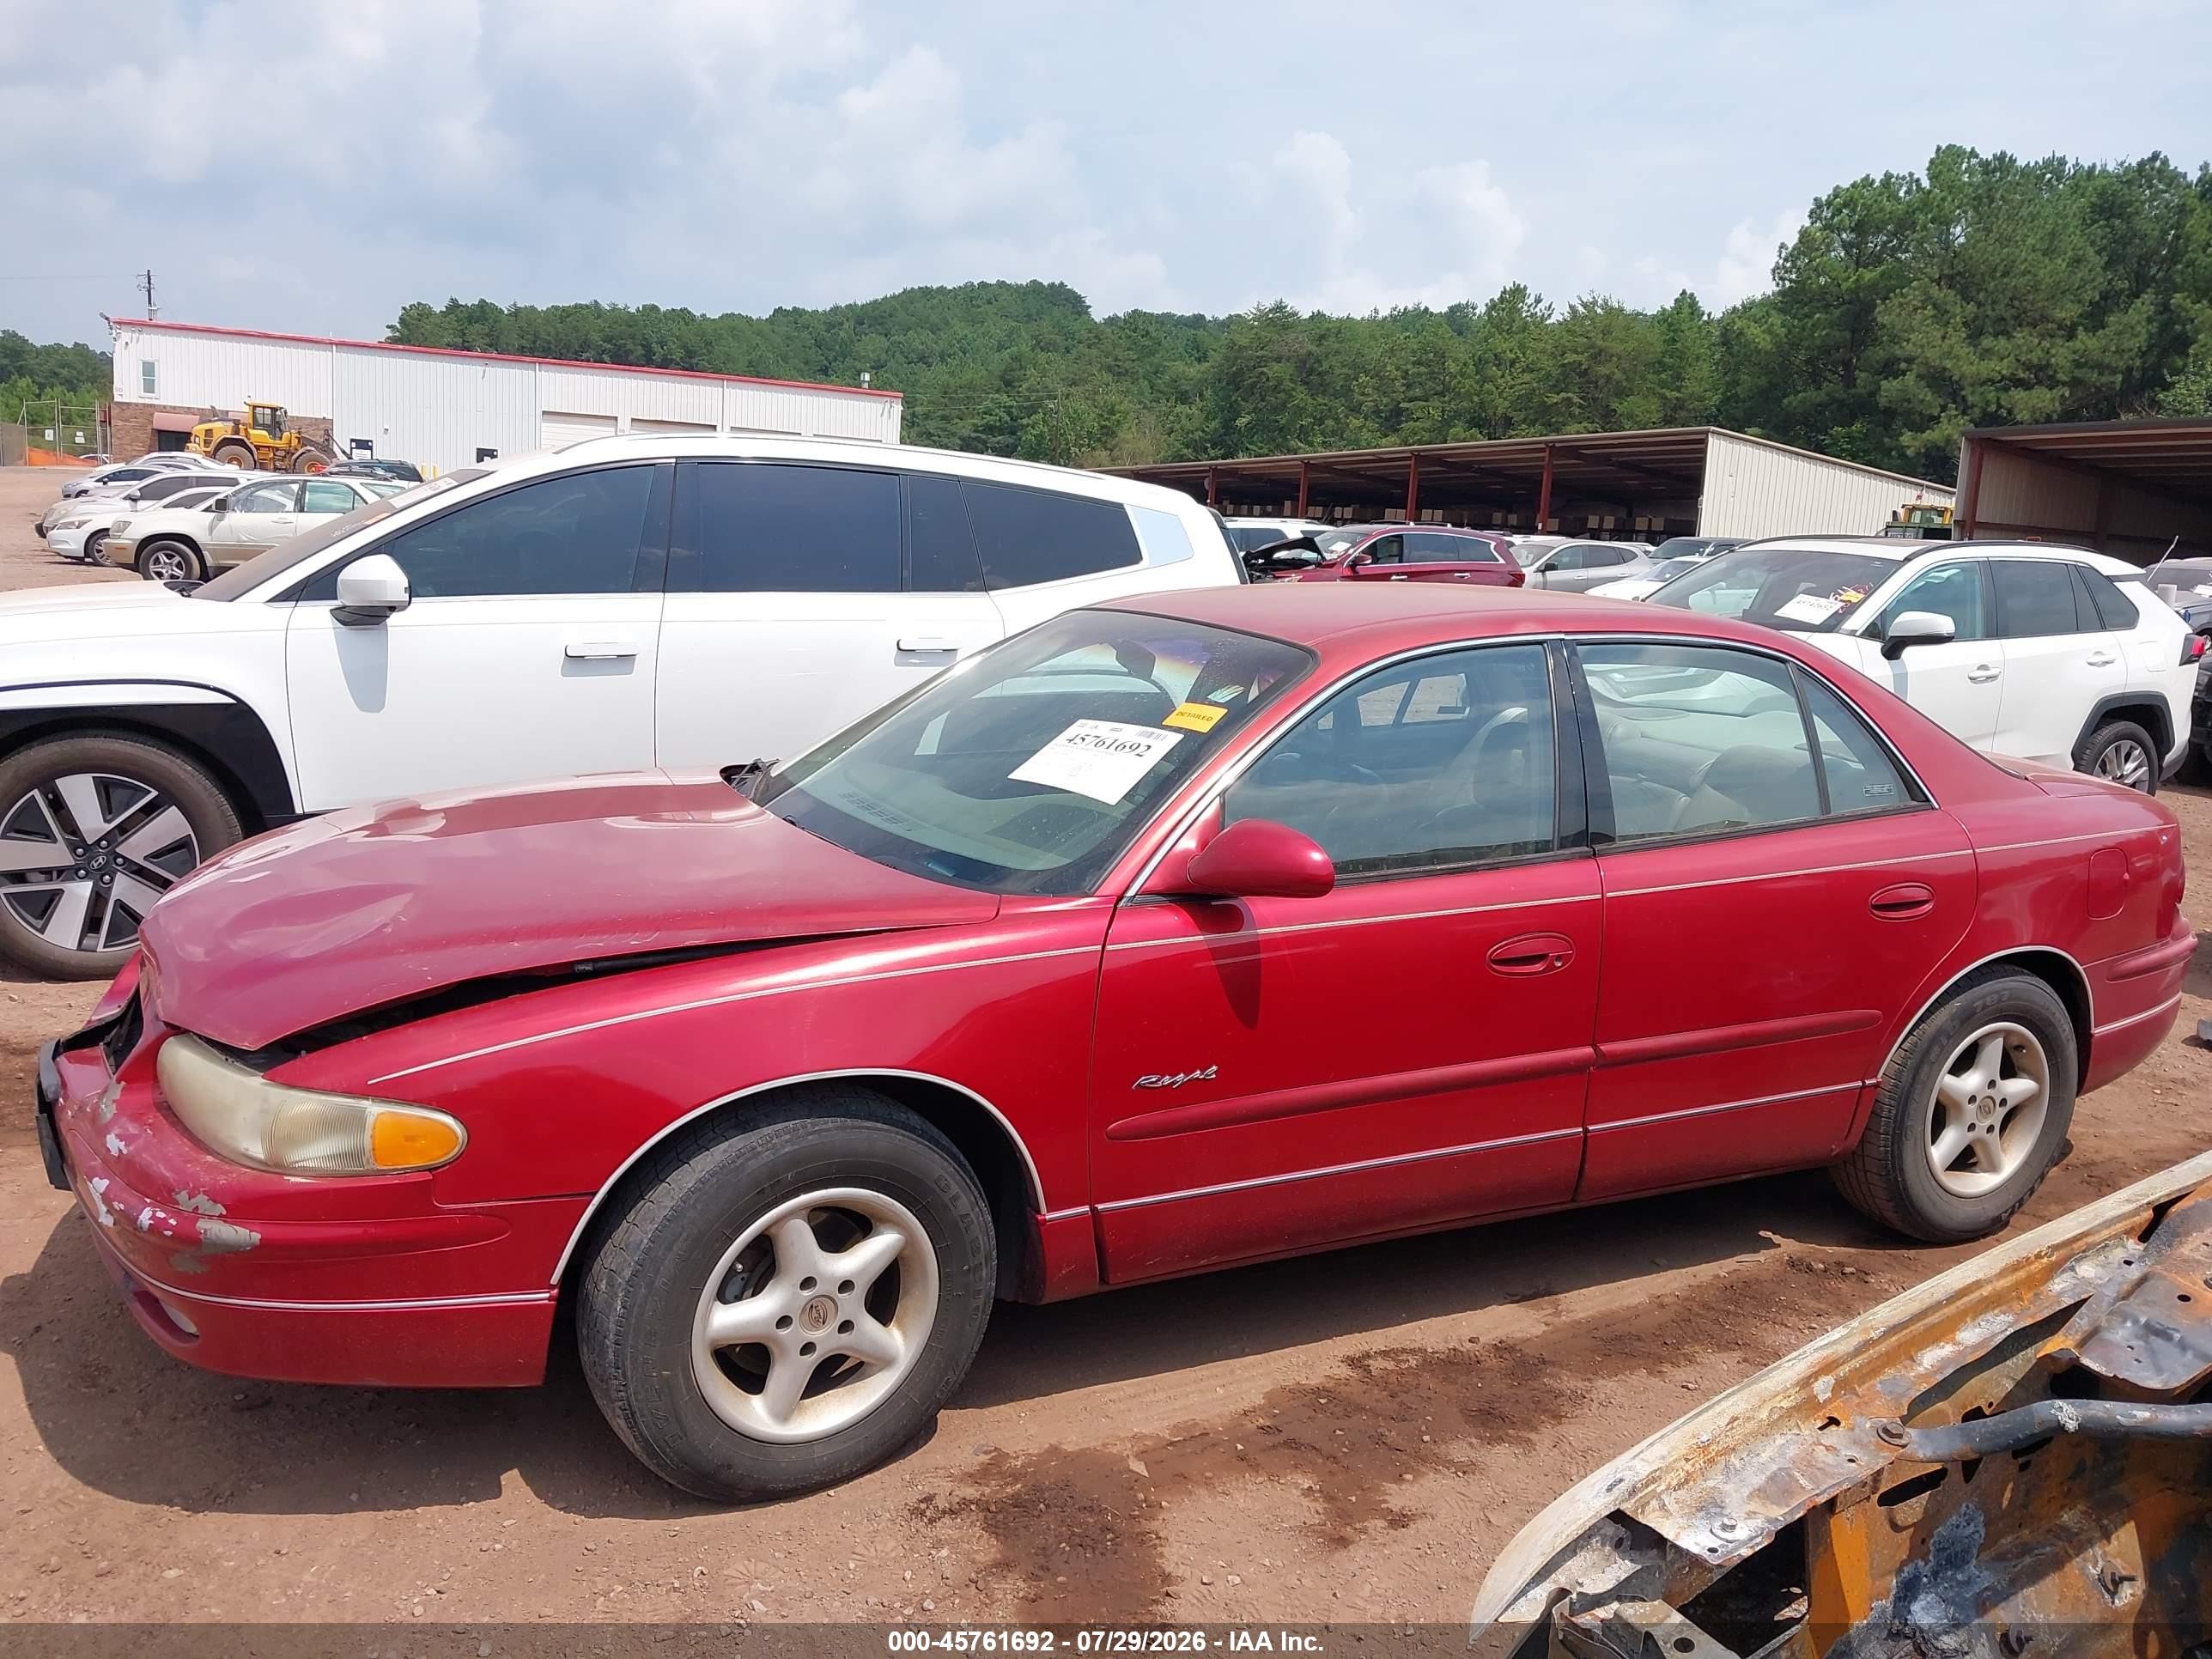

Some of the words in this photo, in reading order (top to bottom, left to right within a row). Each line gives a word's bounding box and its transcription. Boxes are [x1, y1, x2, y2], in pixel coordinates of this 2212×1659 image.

[1175, 710, 1213, 722] DETAILED
[1066, 732, 1152, 758] 45761692
[1132, 1064, 1218, 1090] Regal
